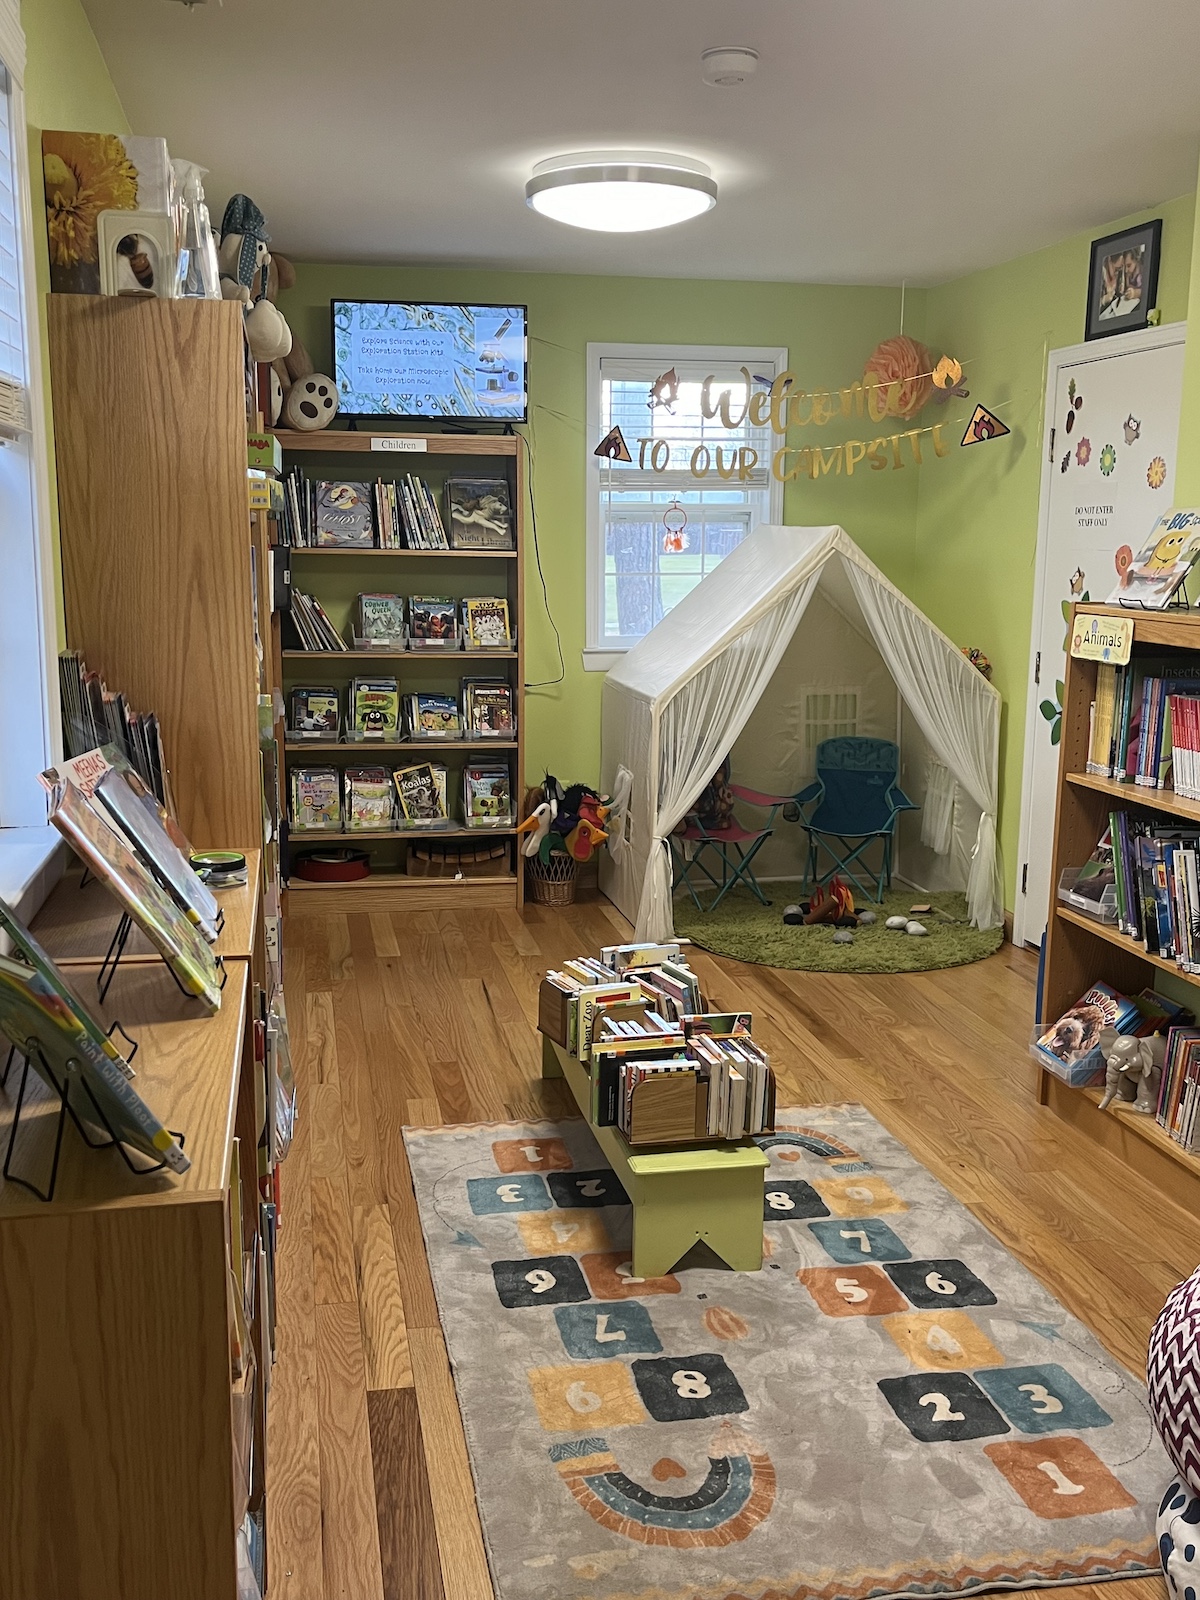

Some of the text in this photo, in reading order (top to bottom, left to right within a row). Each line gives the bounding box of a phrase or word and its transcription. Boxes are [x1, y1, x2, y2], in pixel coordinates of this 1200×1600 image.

[361, 346, 401, 355] Exploration
[403, 347, 428, 355] Station
[362, 337, 387, 346] Explore
[415, 338, 430, 346] with
[357, 366, 373, 374] Take
[374, 366, 392, 374] home
[408, 368, 449, 377] Microscopic
[375, 376, 415, 385] Exploration
[701, 366, 917, 434] Welcome
[381, 439, 416, 450] Children
[636, 436, 671, 474] TO
[690, 446, 759, 480] OUR
[1075, 505, 1113, 515] DO NOT ENTER
[1078, 518, 1108, 527] STAFF ONLY
[1167, 512, 1195, 531] BIG
[457, 533, 480, 543] Night
[1083, 630, 1122, 648] Animals
[72, 753, 106, 781] MEENA'S
[401, 775, 431, 790] Koalas
[583, 1000, 592, 1052] Dear Zoo
[75, 1031, 104, 1063] Paint
[102, 1064, 128, 1095] with
[519, 1145, 544, 1164] 1
[496, 1183, 523, 1203] 3
[575, 1179, 607, 1198] 2
[845, 1185, 874, 1205] 9
[765, 1191, 796, 1211] 8
[839, 1229, 872, 1253] 7
[834, 1277, 869, 1304] 5
[924, 1271, 957, 1295] 6
[594, 1313, 627, 1344] 7
[925, 1323, 964, 1356] 4
[671, 1369, 713, 1400] 8
[918, 1391, 966, 1423] 2
[1017, 1383, 1064, 1415] 3
[1036, 1460, 1086, 1496] 1
